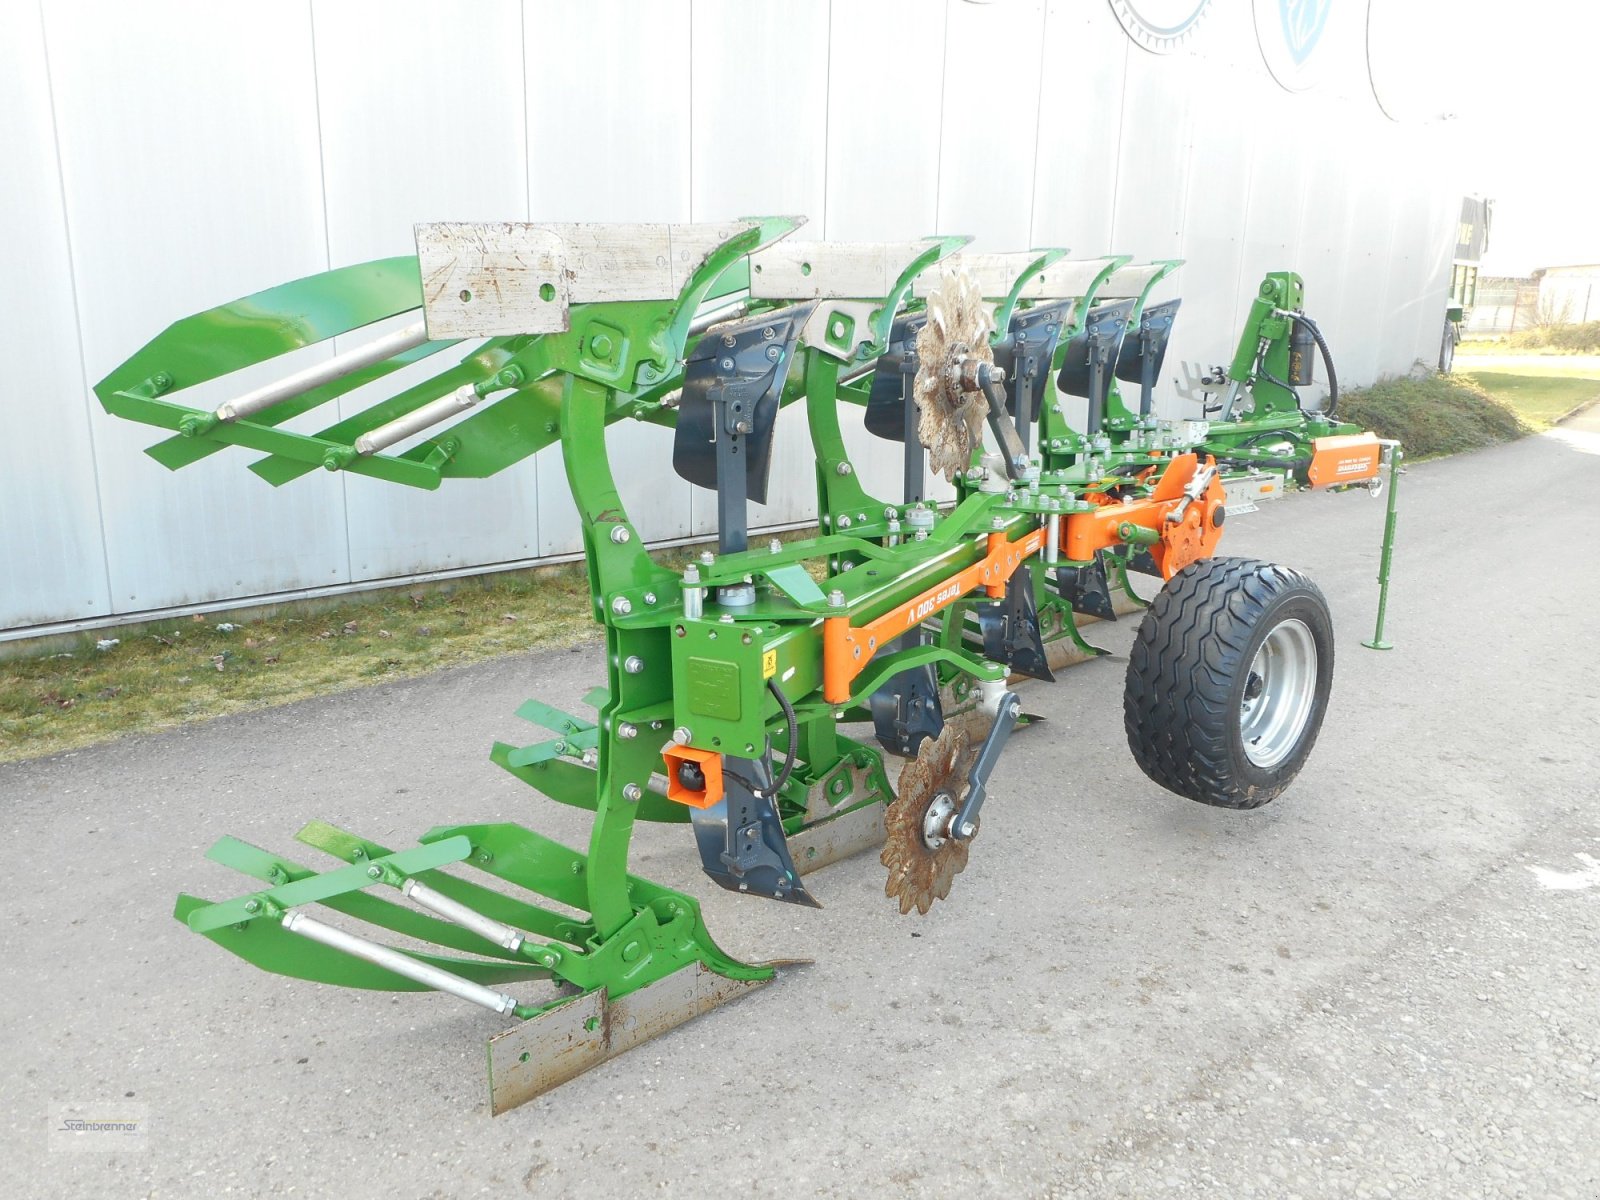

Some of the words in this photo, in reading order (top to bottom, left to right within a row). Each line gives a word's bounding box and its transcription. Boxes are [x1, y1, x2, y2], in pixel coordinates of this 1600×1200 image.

[936, 582, 960, 604] Teres
[907, 608, 915, 625] V
[917, 596, 936, 618] 300
